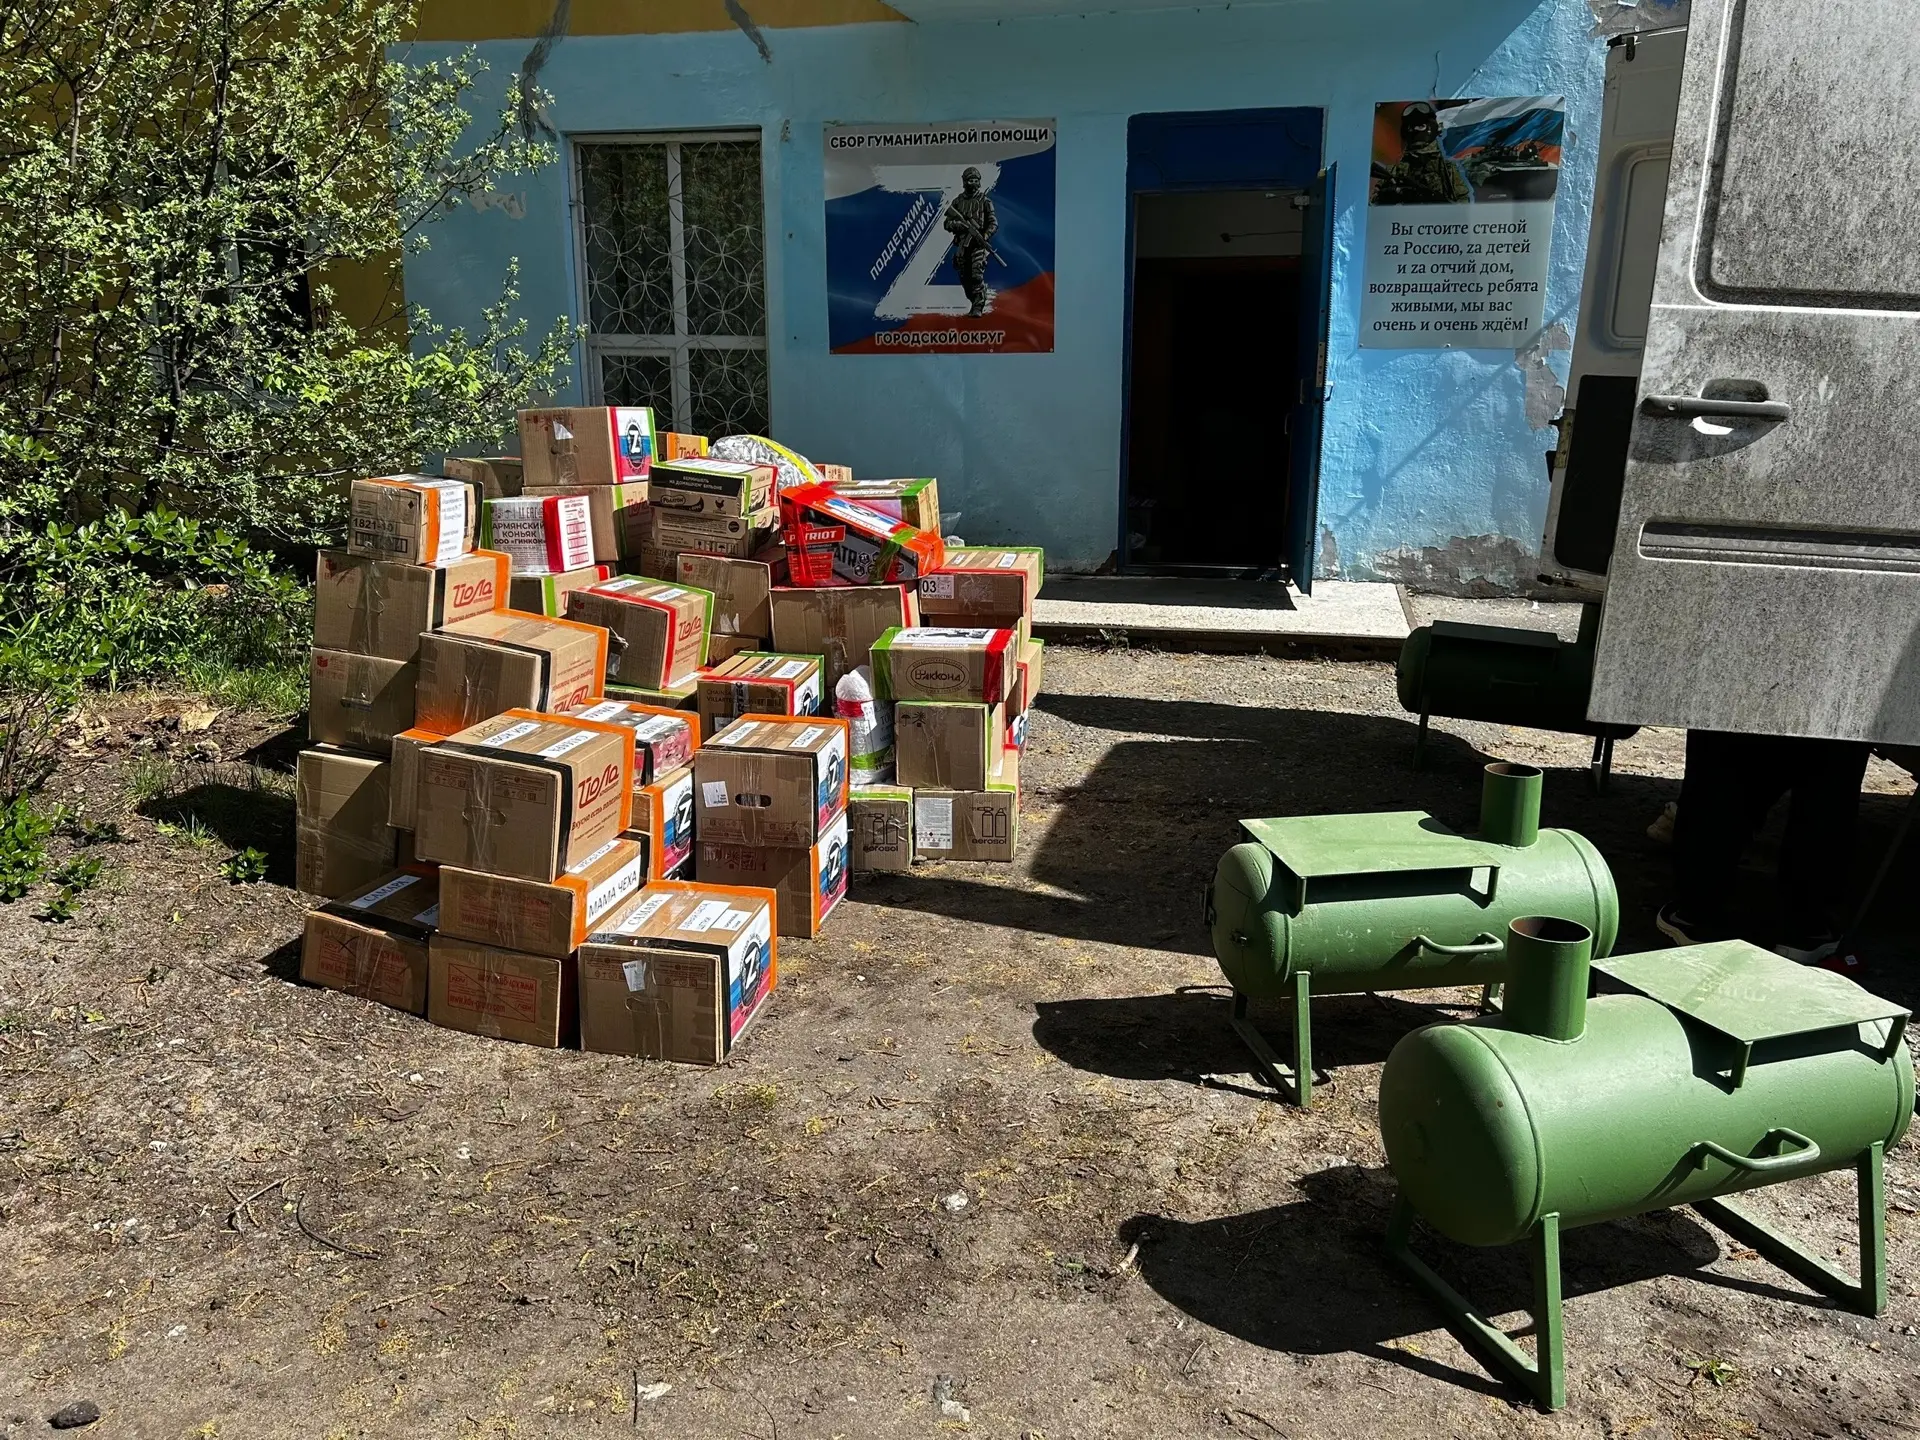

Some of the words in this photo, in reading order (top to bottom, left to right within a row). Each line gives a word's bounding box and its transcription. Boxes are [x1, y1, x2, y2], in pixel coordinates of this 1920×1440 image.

[830, 136, 865, 149] СБОР
[867, 130, 978, 147] ГУМАНИТАРНОЙ
[980, 128, 1048, 143] ПОМОЩИ
[869, 194, 925, 280] ПОДДЕРЖИМ
[900, 202, 935, 260] НАШИХ!
[1391, 222, 1413, 236] Вы
[1417, 224, 1469, 236] стоите
[1473, 219, 1527, 235] стеной
[1403, 241, 1463, 257] Россию,
[1485, 239, 1530, 256] детей
[1397, 264, 1407, 274] и
[1430, 259, 1476, 274] отчий
[1480, 262, 1514, 276] дом,
[1369, 278, 1483, 297] воzвращайтесь
[1487, 277, 1538, 296] ребята
[1390, 301, 1458, 314] живыми,
[1460, 301, 1484, 312] мы
[1488, 301, 1513, 311] вас
[1373, 319, 1416, 332] очень
[1420, 320, 1430, 330] и
[1433, 319, 1478, 331] очень
[1481, 317, 1529, 332] ждём!
[875, 330, 957, 345] ГОРОДСКОЙ
[960, 331, 1005, 344] ОКРУГ
[502, 530, 537, 538] КОНЬЯК
[789, 530, 837, 542] PTRIOT
[922, 580, 937, 593] 03
[678, 799, 693, 834] Z
[364, 880, 409, 902] САМАРА
[588, 886, 616, 919] МАМА
[617, 870, 637, 893] ЧЕХА
[628, 899, 663, 926] САМАРА
[744, 947, 757, 990] Z
